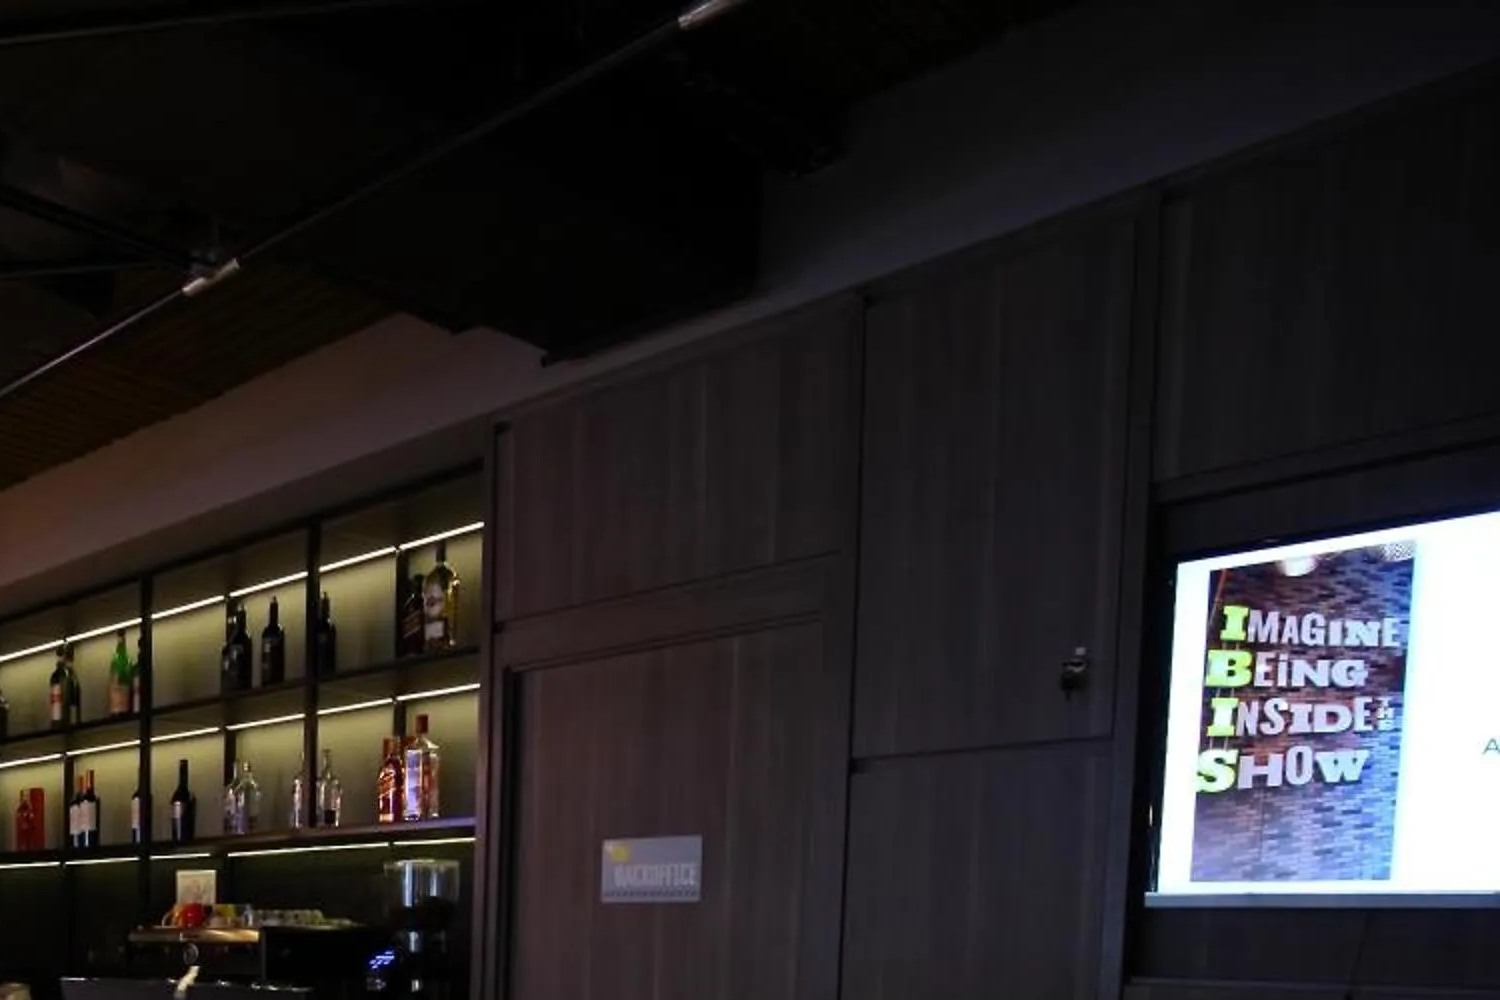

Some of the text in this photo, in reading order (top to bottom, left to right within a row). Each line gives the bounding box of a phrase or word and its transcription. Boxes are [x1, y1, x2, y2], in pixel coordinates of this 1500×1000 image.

[1219, 604, 1402, 648] IMAGINE
[1206, 696, 1373, 737] INSIDE
[1195, 744, 1369, 793] SHOW
